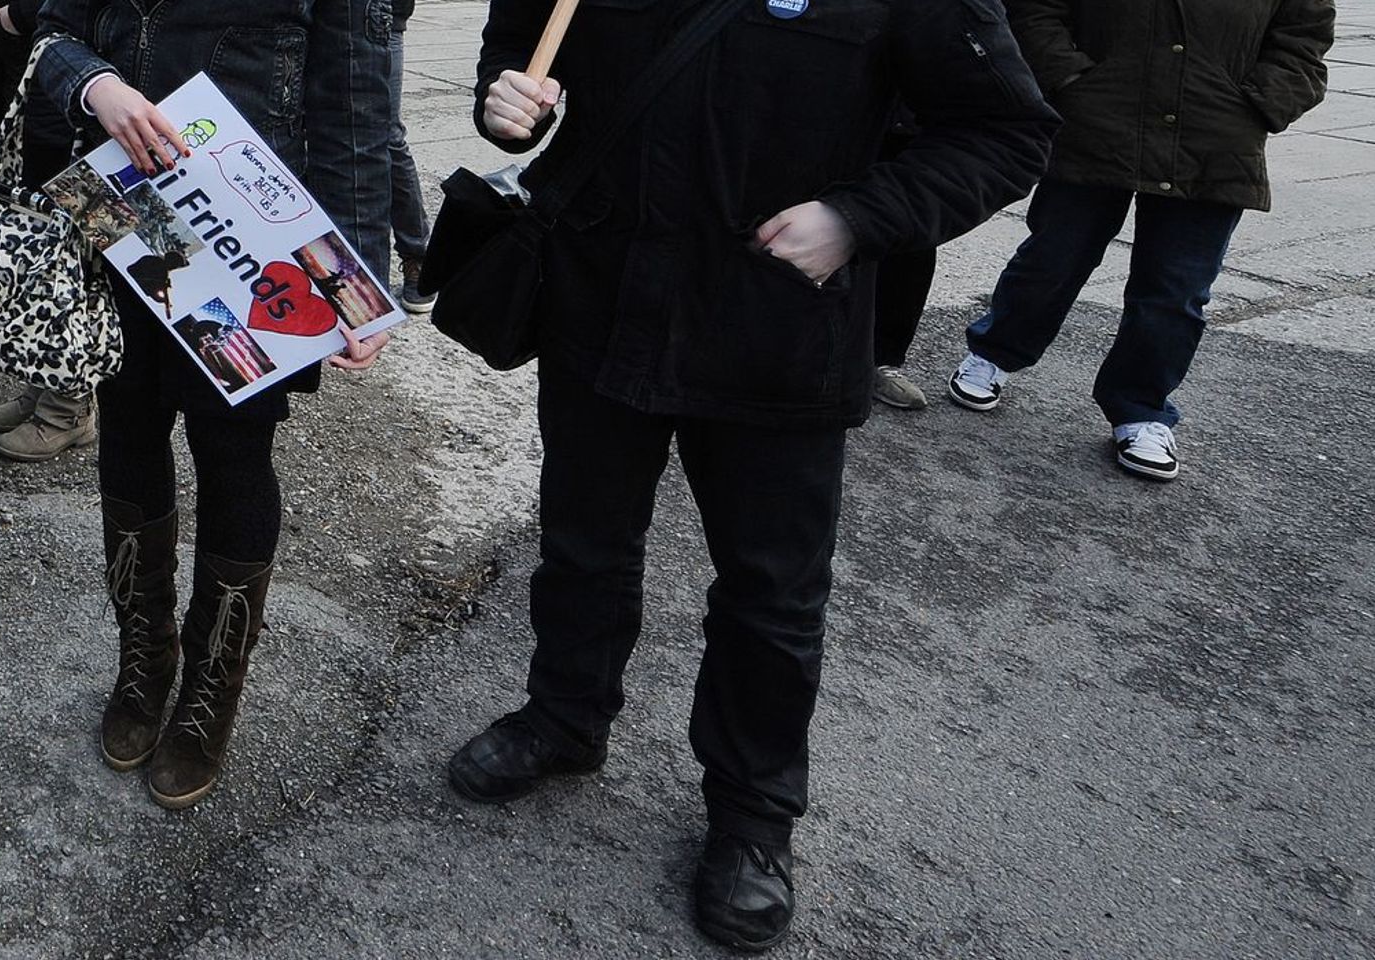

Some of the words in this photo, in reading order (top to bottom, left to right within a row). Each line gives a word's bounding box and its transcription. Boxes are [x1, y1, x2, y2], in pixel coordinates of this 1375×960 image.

[768, 0, 803, 12] CHARLIE
[241, 144, 267, 173] Wanna
[254, 176, 280, 200] BEER
[174, 187, 296, 321] Friends
